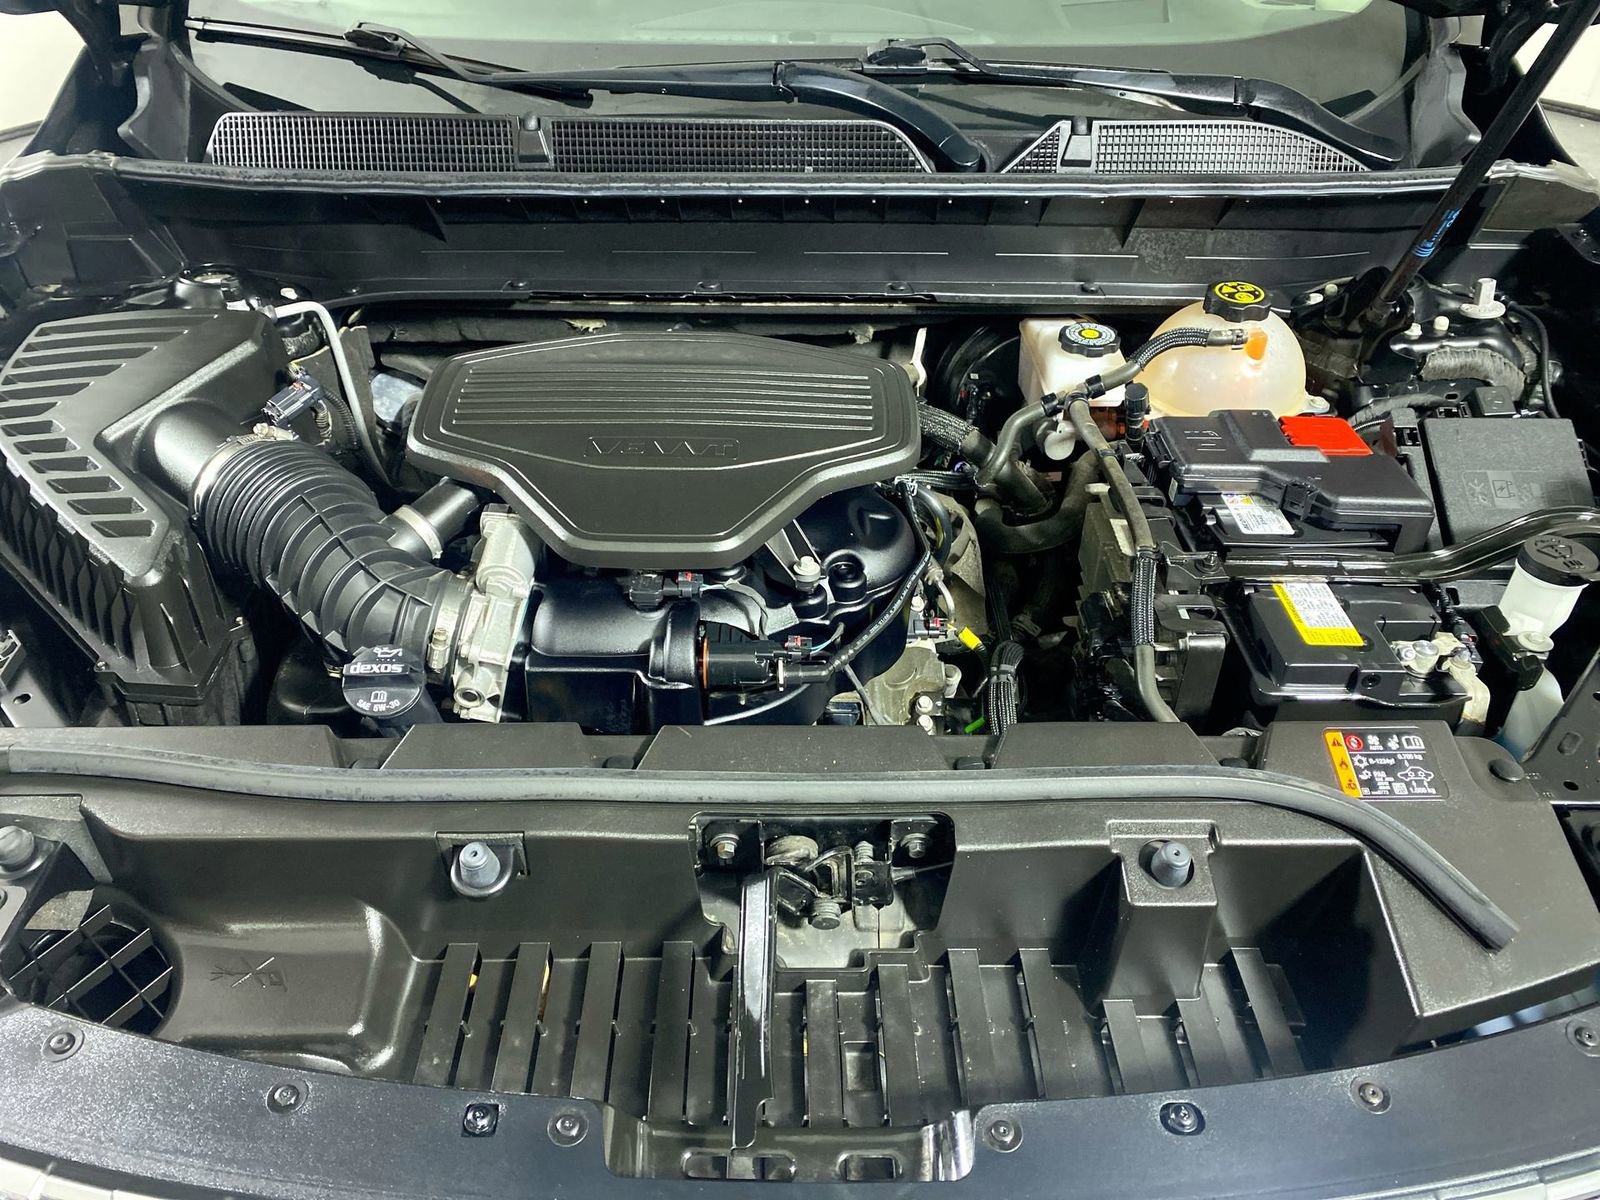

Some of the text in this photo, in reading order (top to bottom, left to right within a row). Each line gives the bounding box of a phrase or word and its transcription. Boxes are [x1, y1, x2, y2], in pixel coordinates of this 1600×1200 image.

[653, 440, 735, 457] VVT
[350, 662, 405, 674] dexos
[356, 699, 401, 712] SAE 5W-30
